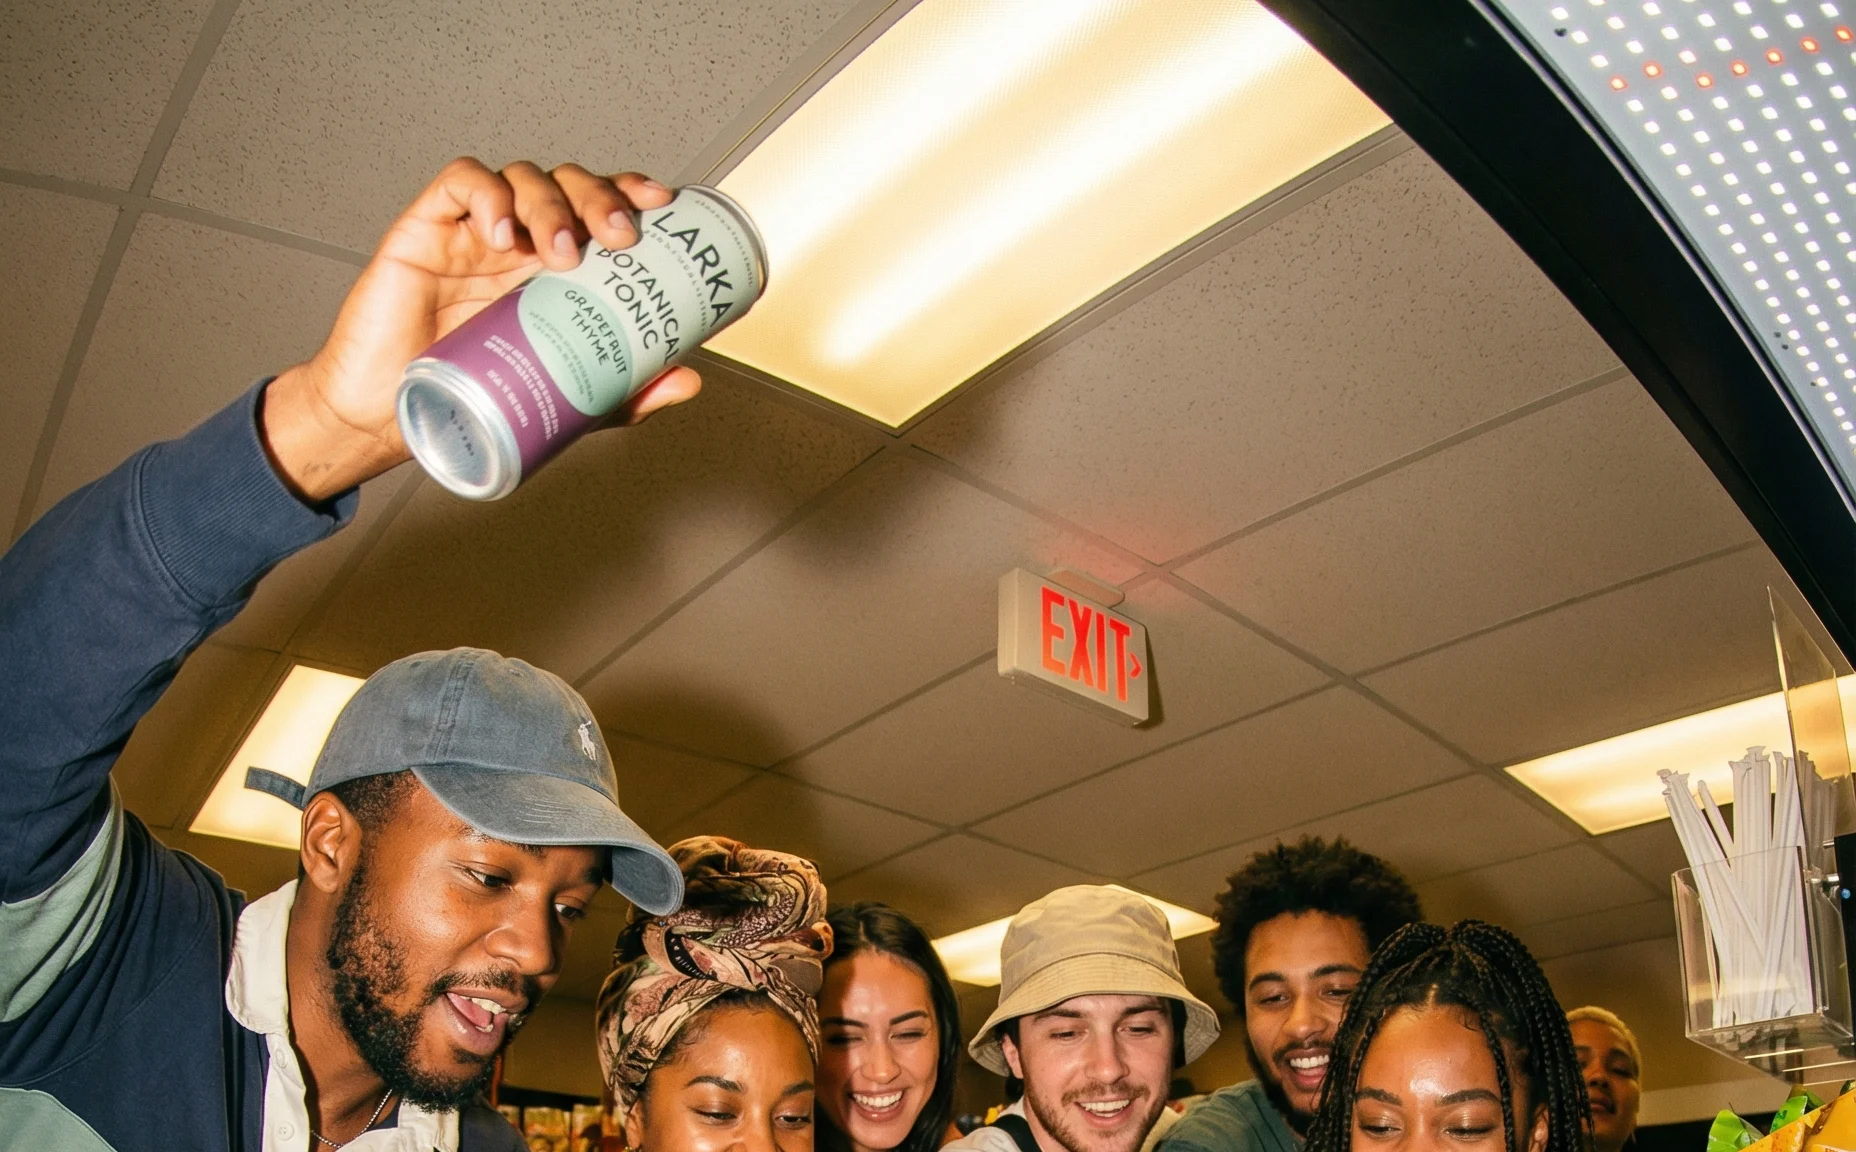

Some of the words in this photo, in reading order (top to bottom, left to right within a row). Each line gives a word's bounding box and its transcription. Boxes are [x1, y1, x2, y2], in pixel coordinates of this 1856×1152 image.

[604, 271, 659, 350] TONIC
[652, 211, 734, 328] LARKA
[565, 290, 627, 374] GRAPEFRUIT
[570, 311, 611, 366] THYME
[1041, 586, 1132, 703] EXIT
